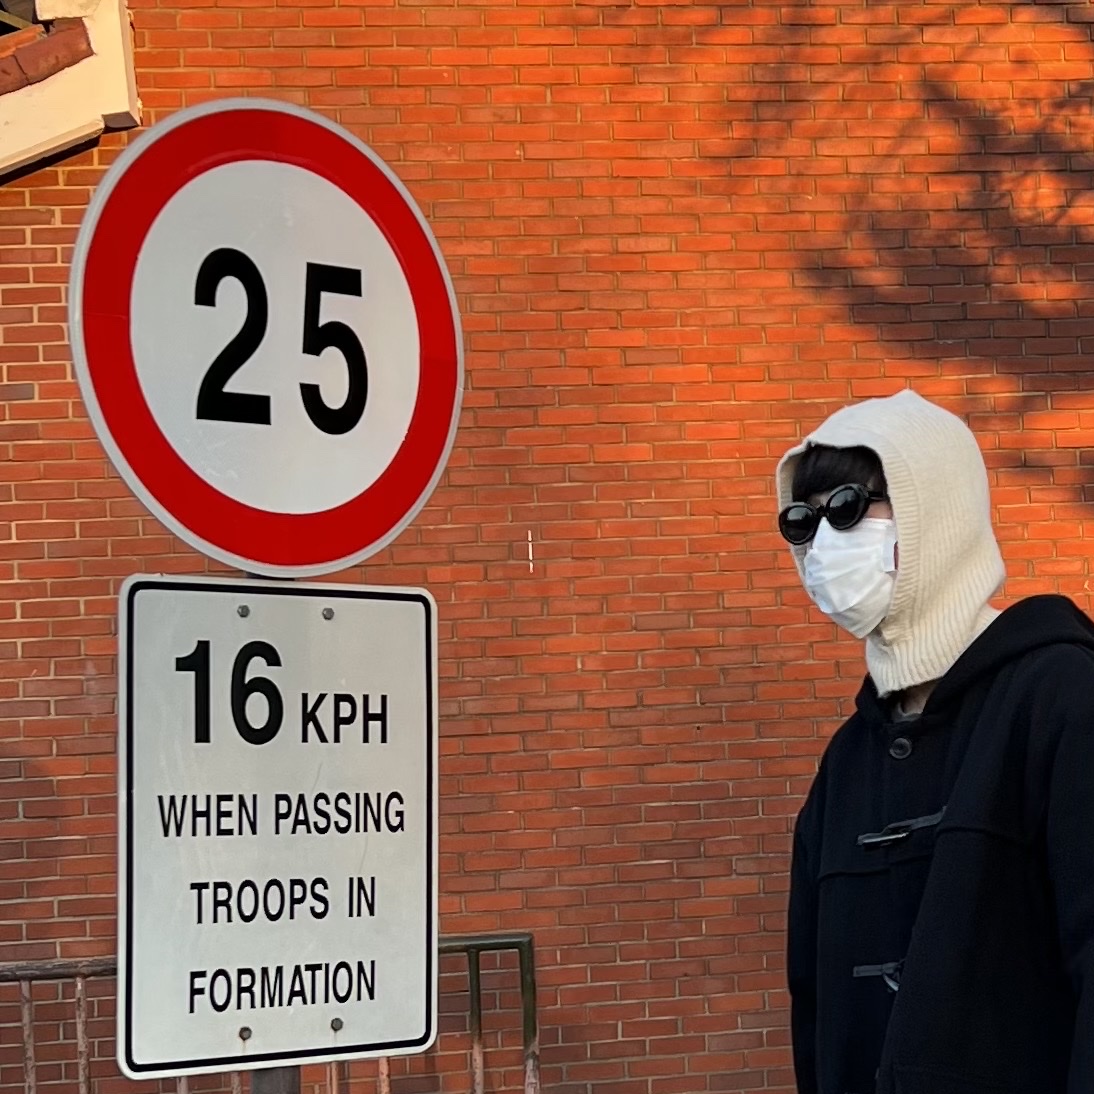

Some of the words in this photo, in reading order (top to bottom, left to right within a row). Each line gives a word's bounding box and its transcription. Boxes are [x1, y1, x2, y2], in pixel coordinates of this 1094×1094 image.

[195, 247, 368, 435] 25
[175, 639, 284, 746] 16
[301, 692, 388, 744] KPH
[157, 793, 258, 838] WHEN
[274, 791, 405, 835] PASSING
[190, 877, 330, 925] TROOPS
[348, 876, 376, 918] IN
[188, 959, 376, 1014] FORMATION
